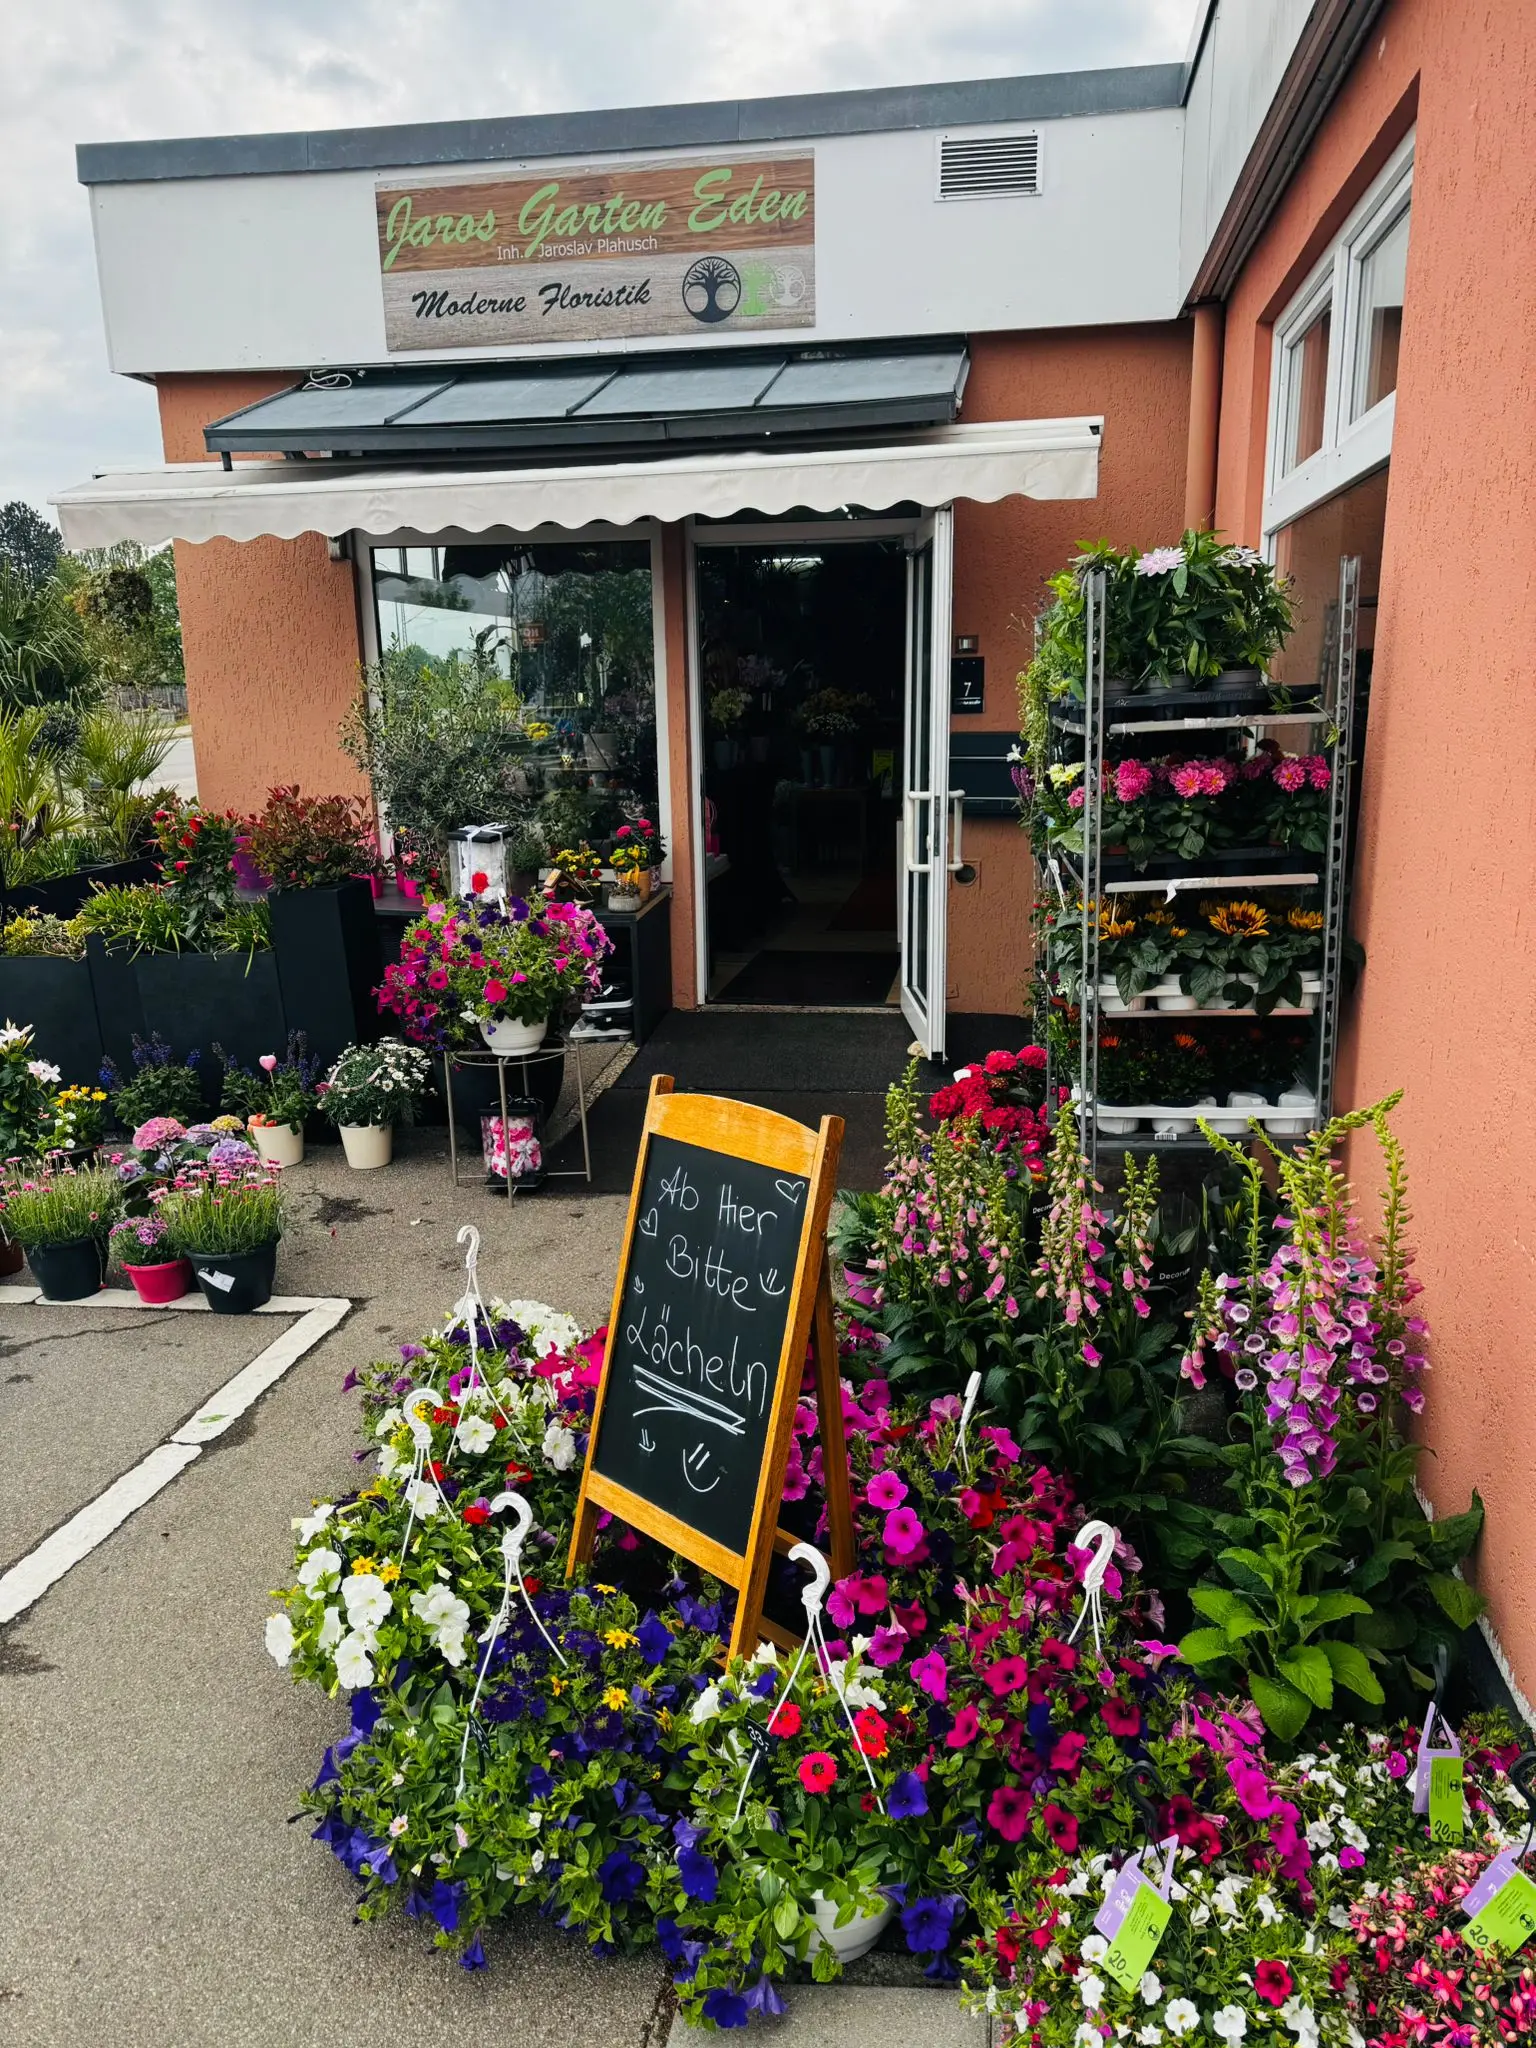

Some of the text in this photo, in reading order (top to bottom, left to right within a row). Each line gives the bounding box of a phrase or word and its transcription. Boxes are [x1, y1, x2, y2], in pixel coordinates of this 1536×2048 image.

[383, 168, 808, 271] Jaros Garten Eden
[496, 234, 658, 261] Inh. Jaroslav Plahusch
[411, 278, 652, 319] Moderne Floristik
[964, 681, 972, 697] 7
[658, 1166, 778, 1235] Ab Hier
[666, 1234, 757, 1311] Bitte
[627, 1304, 768, 1418] Lächeln
